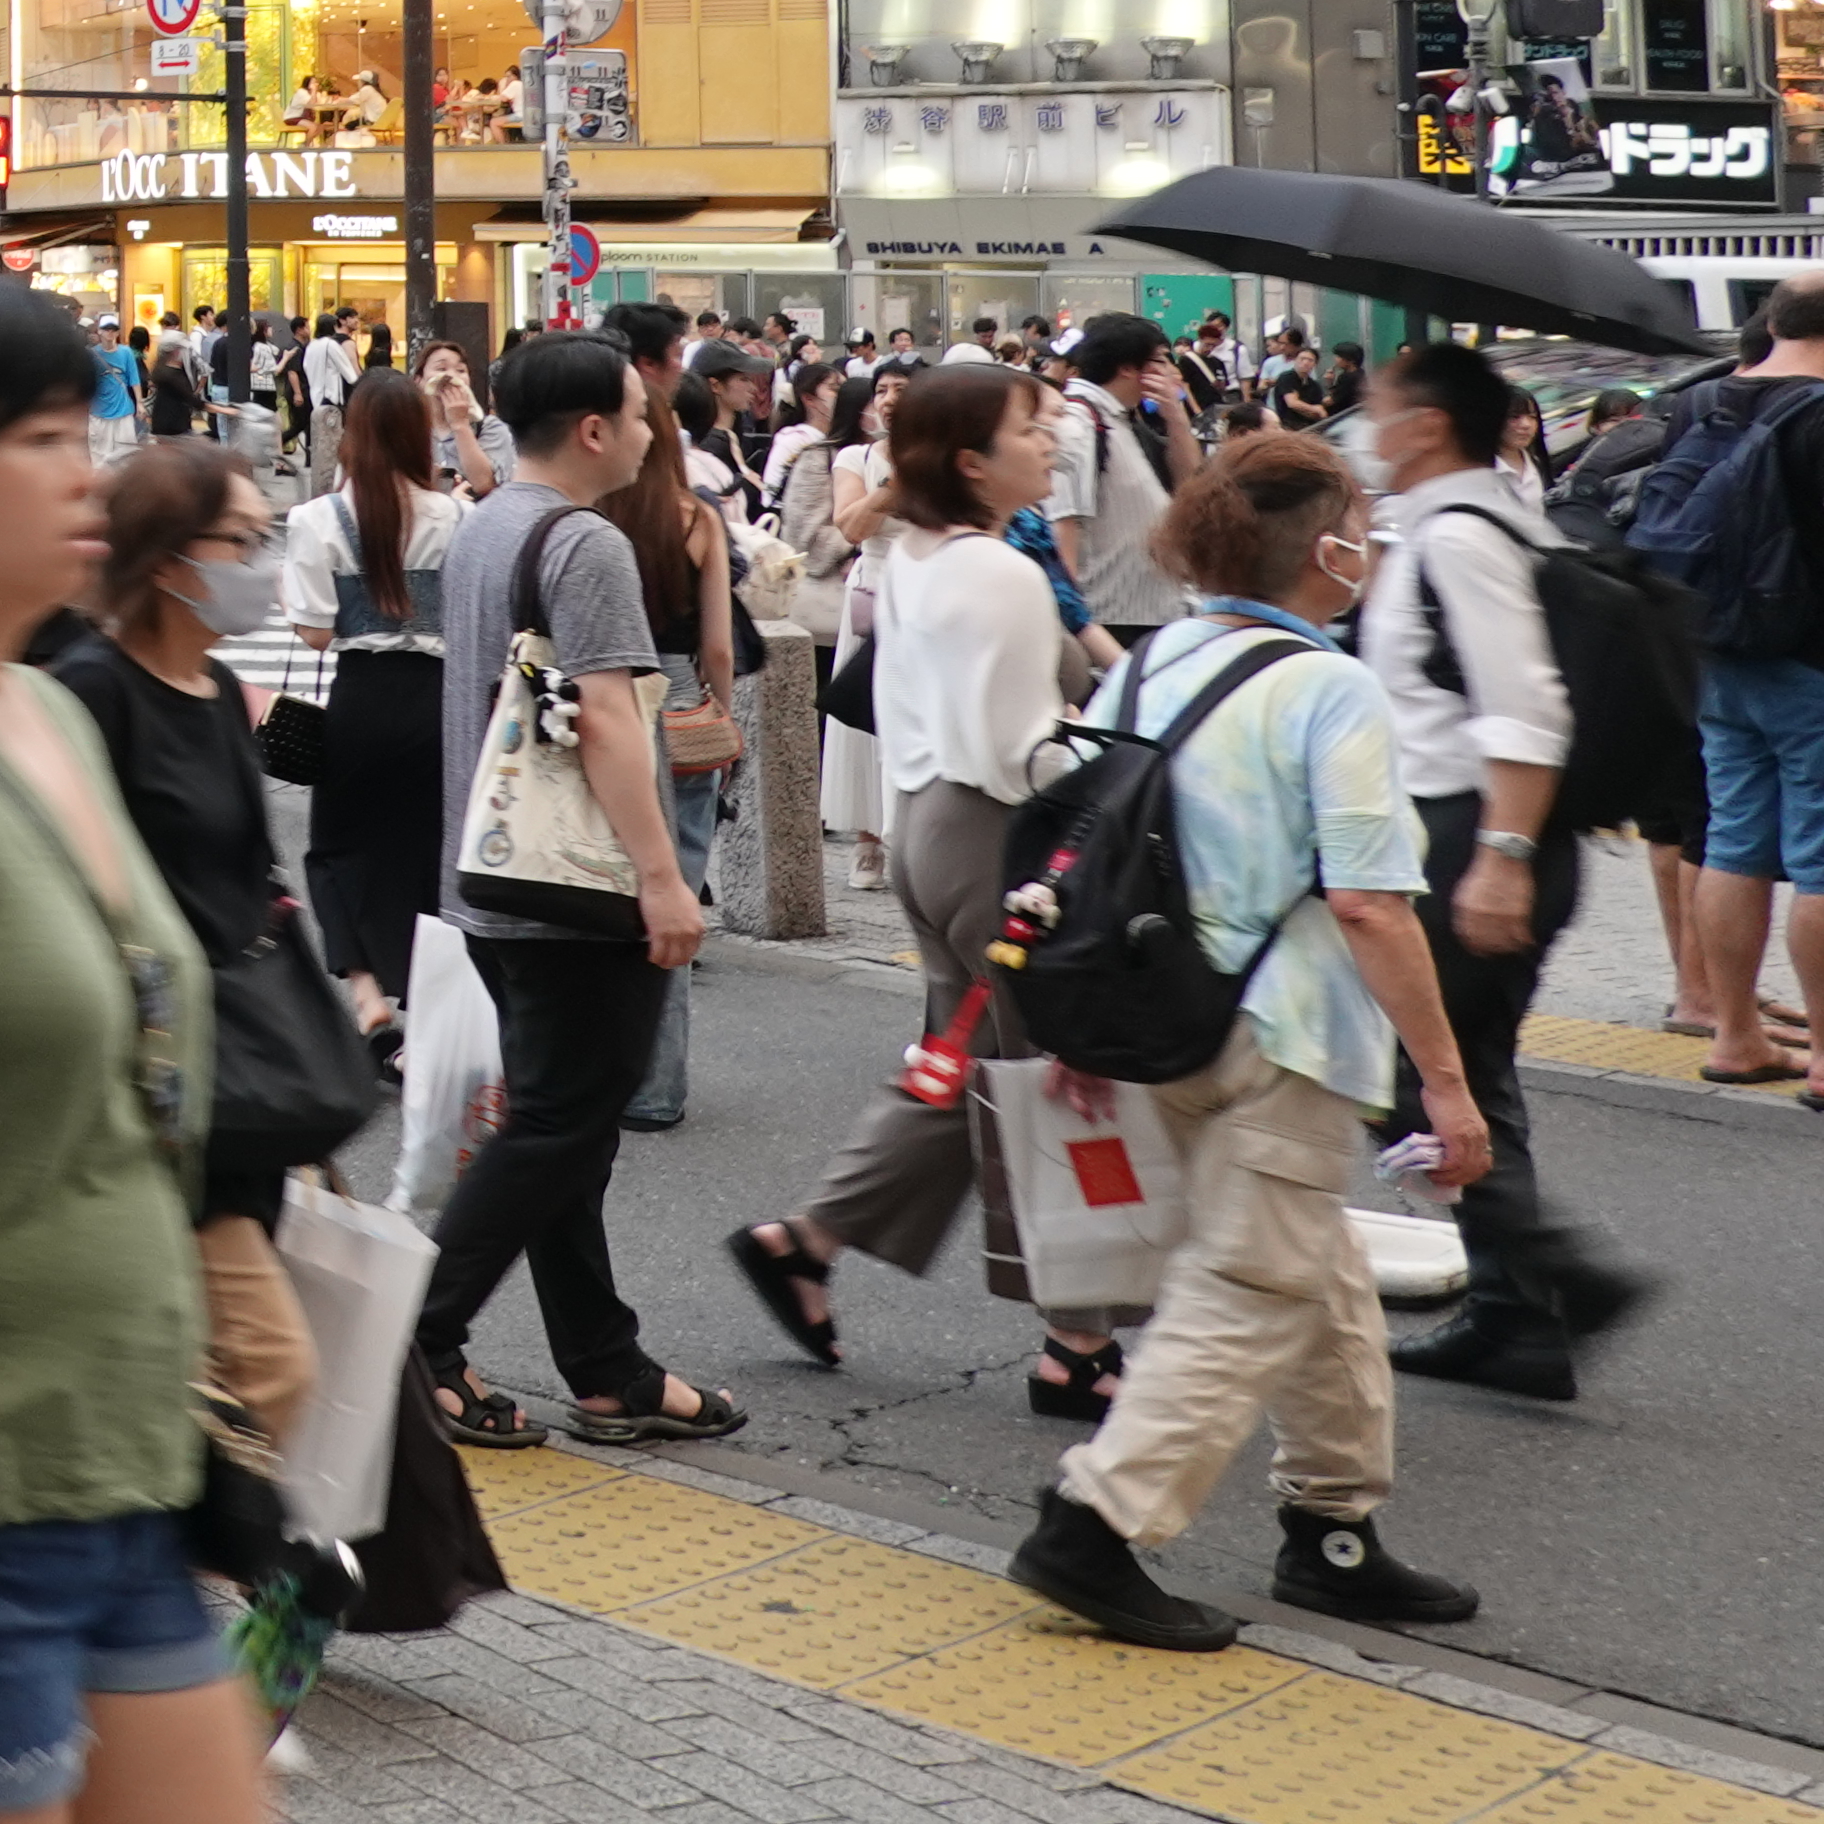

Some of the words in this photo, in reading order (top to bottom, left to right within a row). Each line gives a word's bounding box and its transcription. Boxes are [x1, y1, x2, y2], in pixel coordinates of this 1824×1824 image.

[864, 104, 1185, 131] 渋谷駅前ビル
[101, 148, 356, 201] L'OCCITANE
[312, 213, 398, 231] L'OCCITANE
[866, 240, 963, 256] SHIBUYA
[975, 240, 1066, 256] EKIMAE
[600, 249, 642, 271] ploom
[645, 252, 699, 263] STATION
